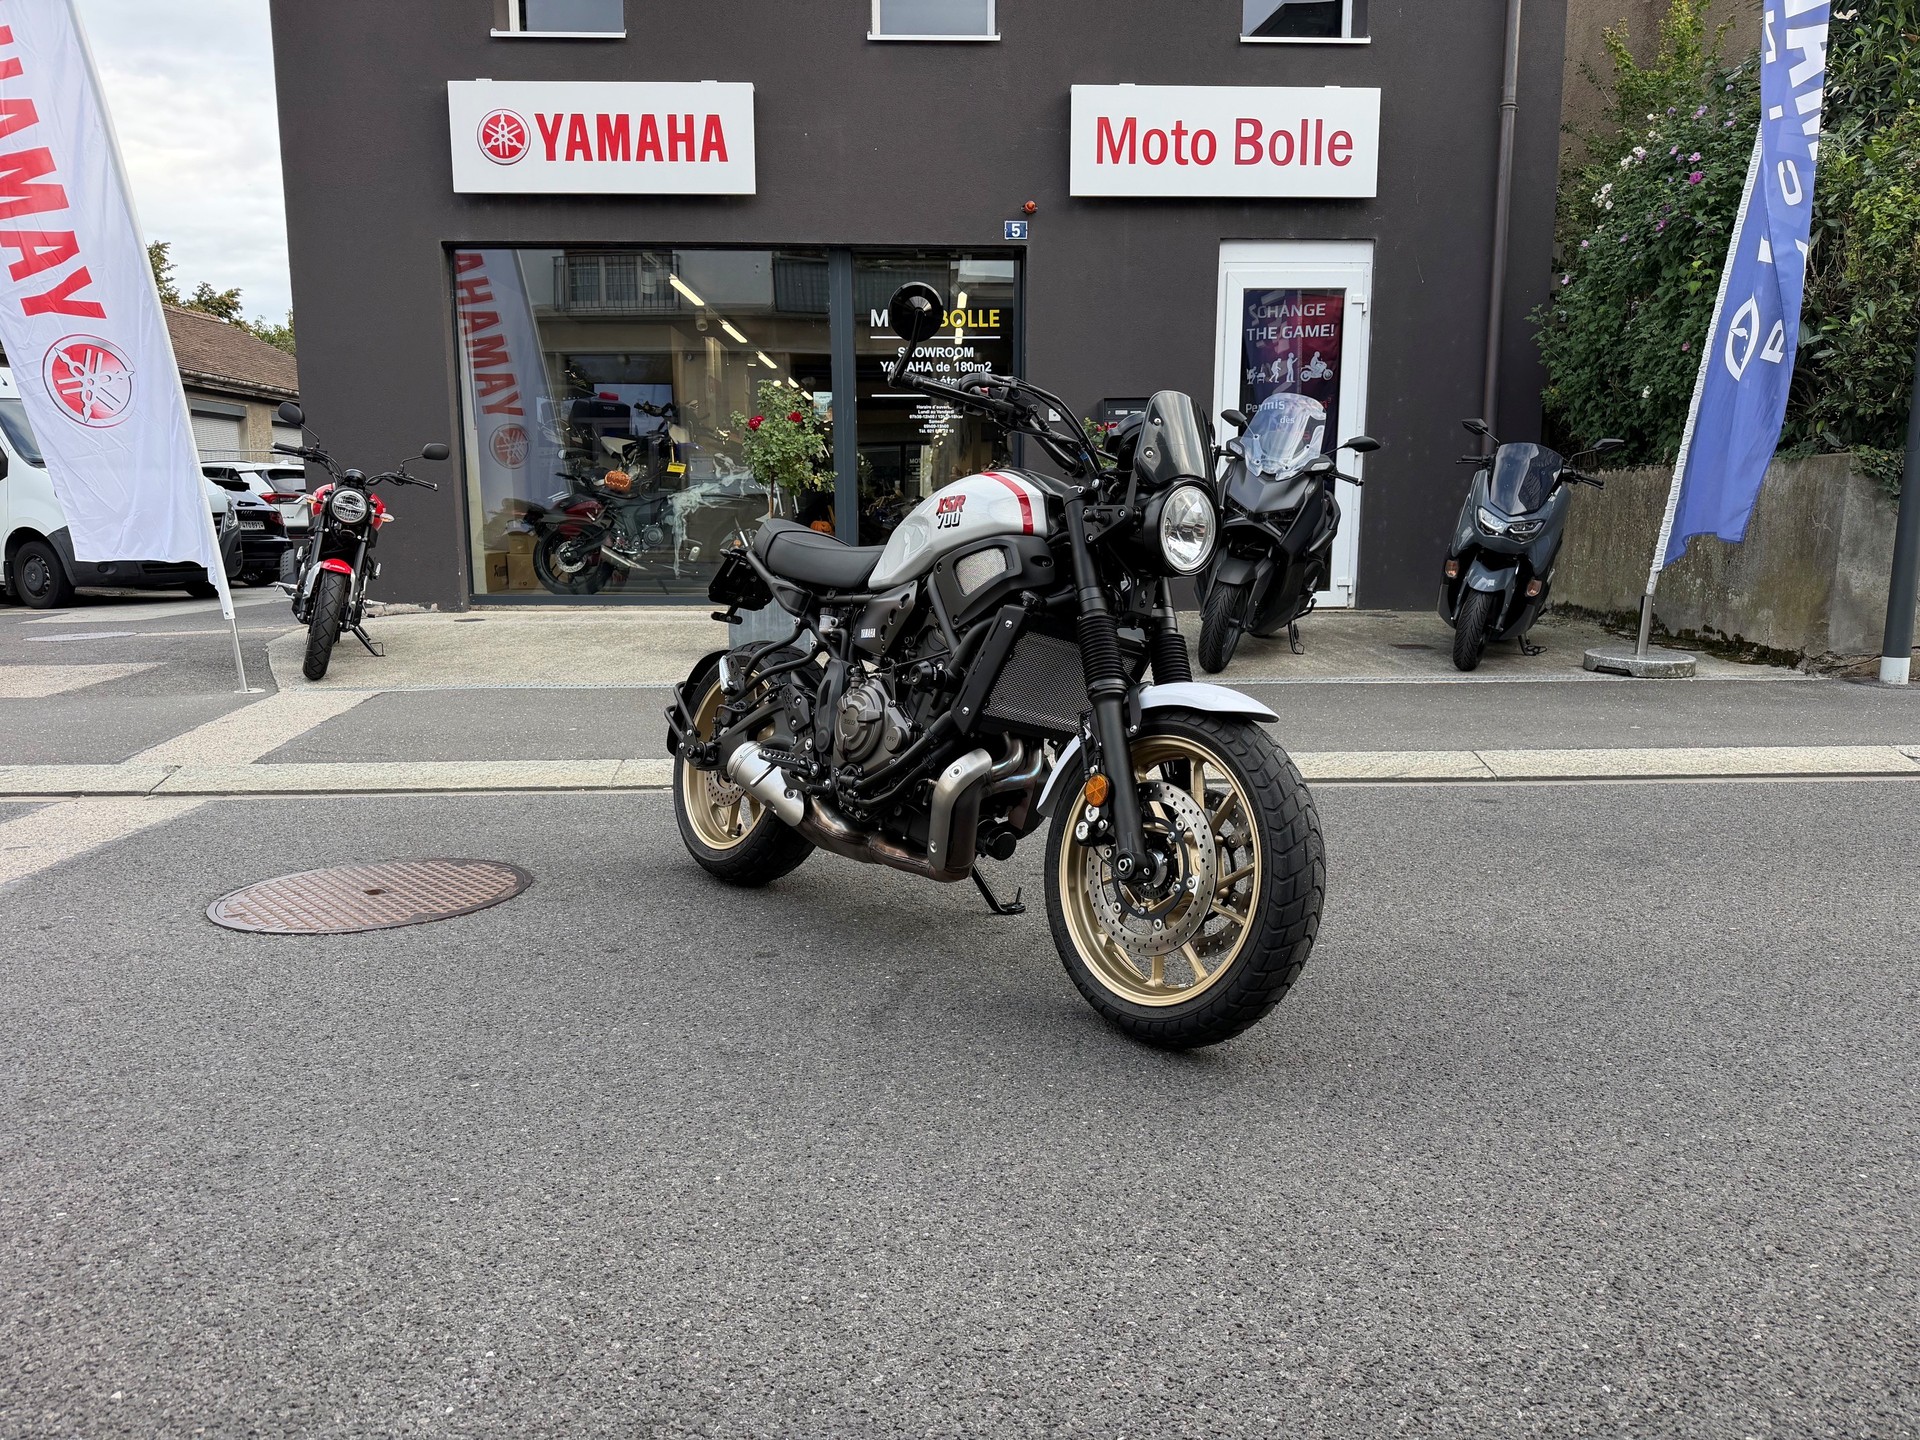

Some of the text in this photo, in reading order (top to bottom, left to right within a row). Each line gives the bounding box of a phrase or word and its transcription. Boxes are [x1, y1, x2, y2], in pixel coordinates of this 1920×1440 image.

[534, 113, 729, 162] YAMAHA
[1096, 116, 1353, 166] Moto Bolle
[1011, 223, 1021, 237] 5
[1246, 324, 1335, 341] THE GAME!
[897, 346, 974, 358] SOWROOM
[880, 361, 992, 372] YAAHA de 180m2
[1245, 399, 1286, 413] Permis
[1280, 415, 1295, 424] dès
[936, 494, 967, 516] XSR
[937, 512, 961, 530] 700
